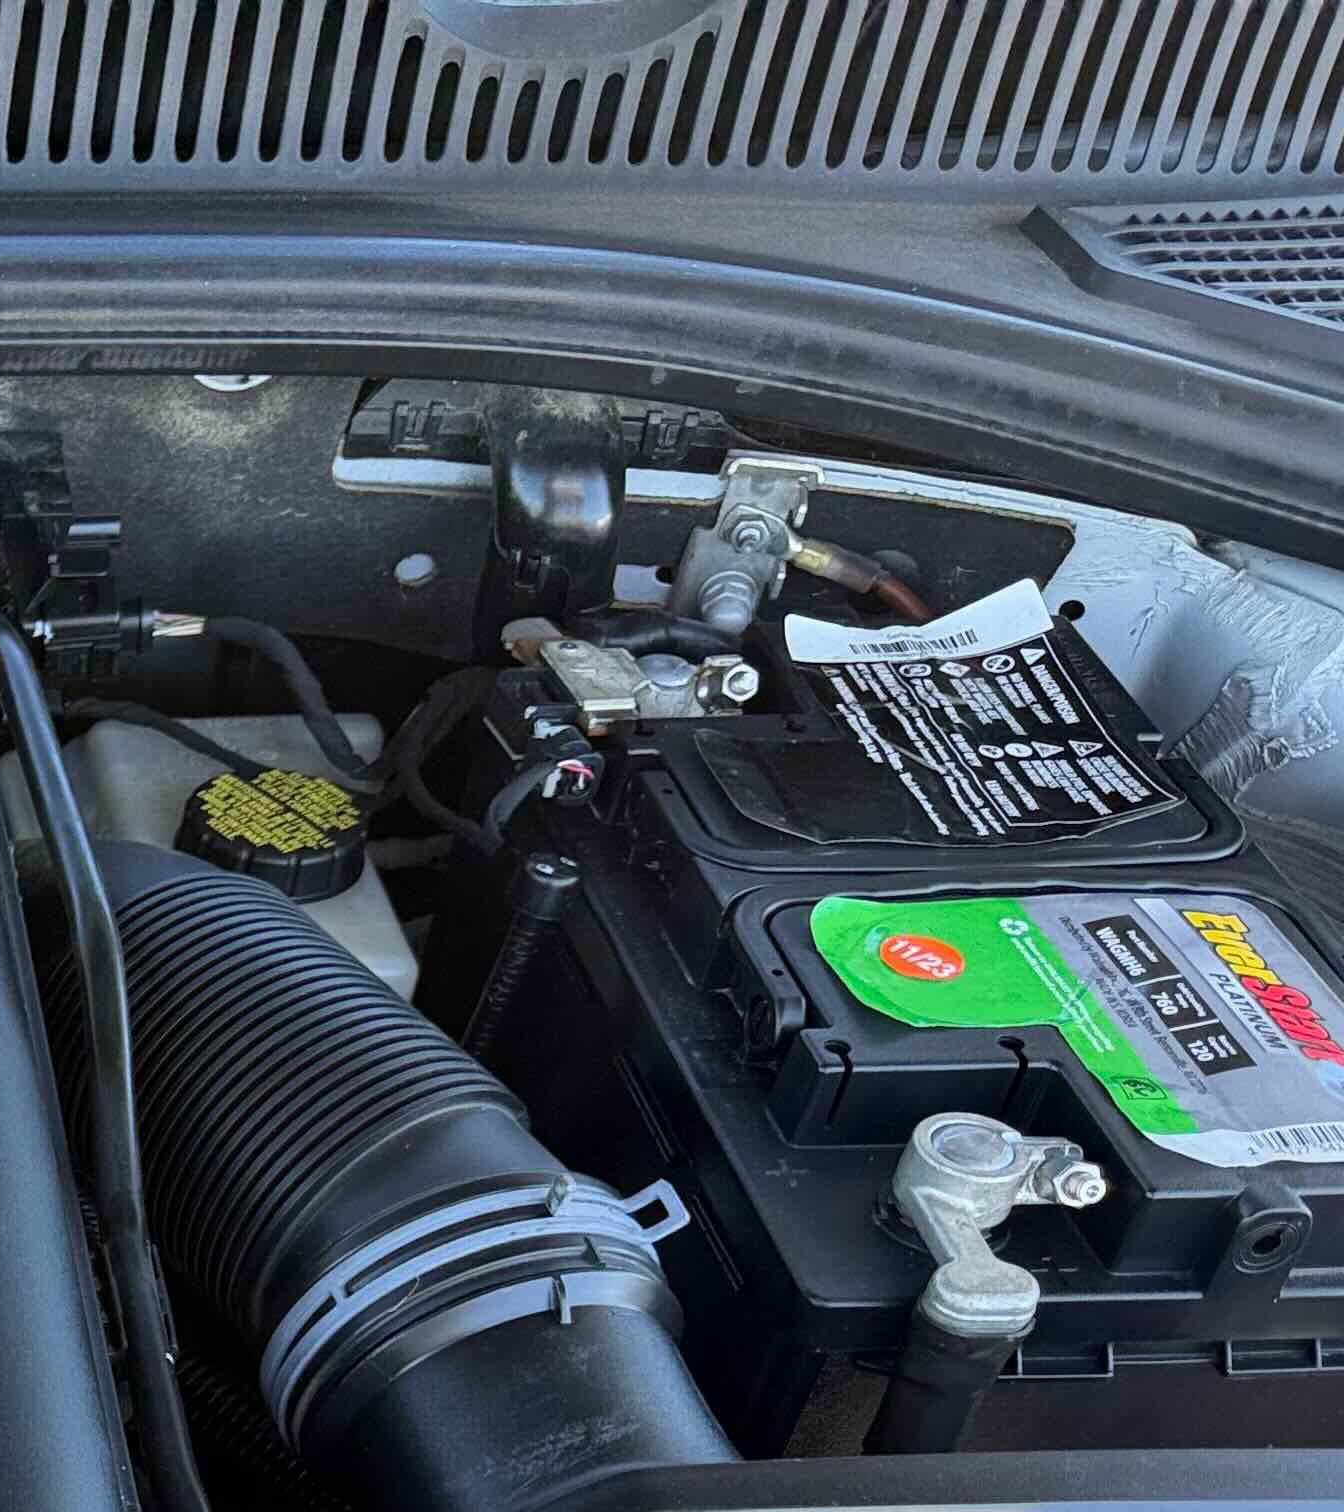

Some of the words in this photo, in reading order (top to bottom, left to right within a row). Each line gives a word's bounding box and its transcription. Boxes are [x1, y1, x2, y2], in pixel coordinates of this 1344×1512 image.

[884, 937, 957, 981] 11/23
[1150, 991, 1179, 1016] 760
[1211, 973, 1289, 1051] PLATINUM
[1187, 1039, 1215, 1062] 120
